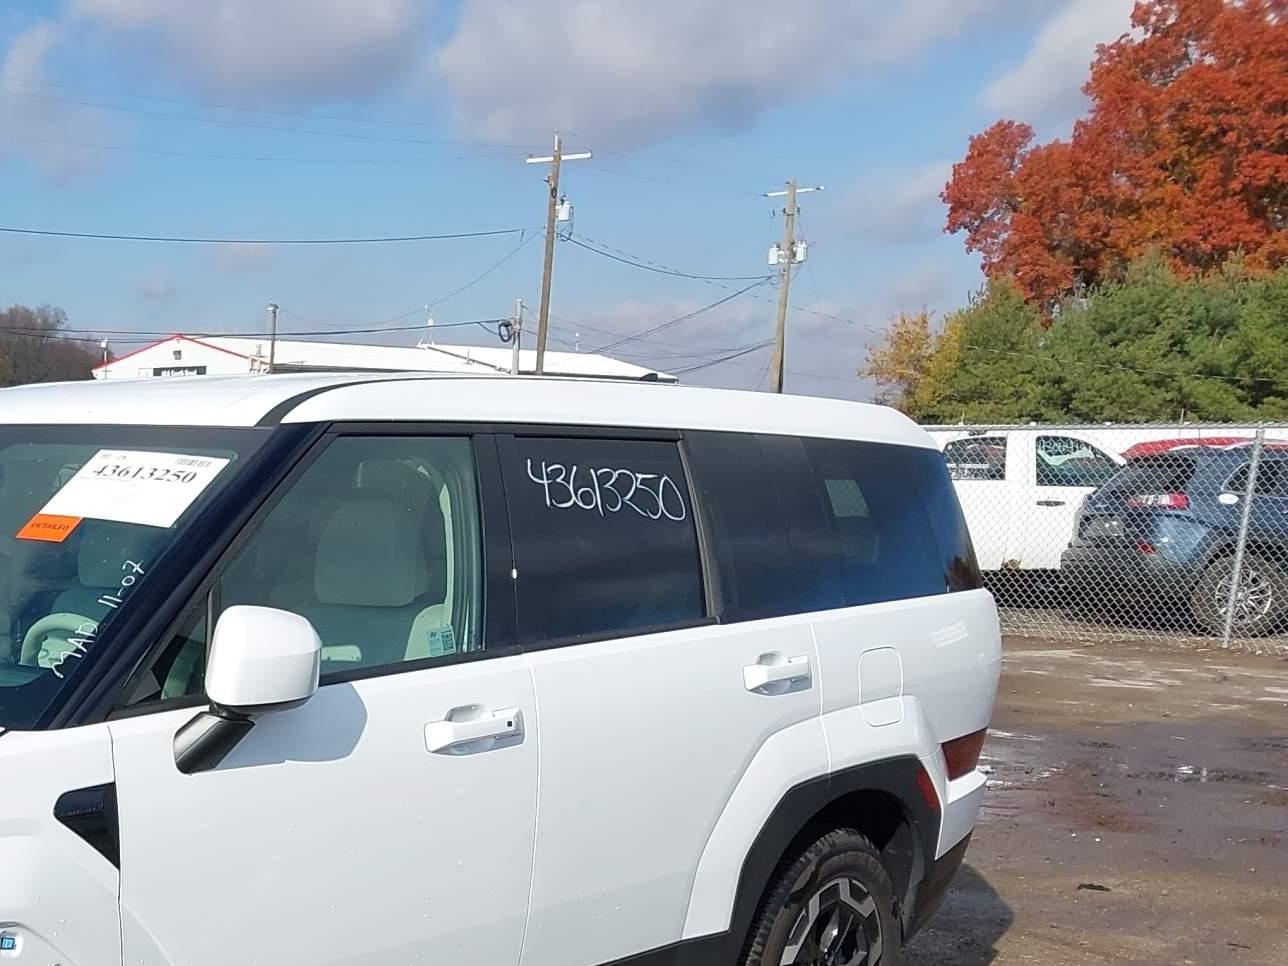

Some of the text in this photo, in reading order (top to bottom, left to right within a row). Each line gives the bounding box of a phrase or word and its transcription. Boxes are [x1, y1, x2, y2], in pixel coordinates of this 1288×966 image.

[92, 464, 197, 484] 43613250
[527, 458, 686, 521] 43613250
[31, 522, 70, 532] DETAILED
[97, 560, 145, 609] 11-07
